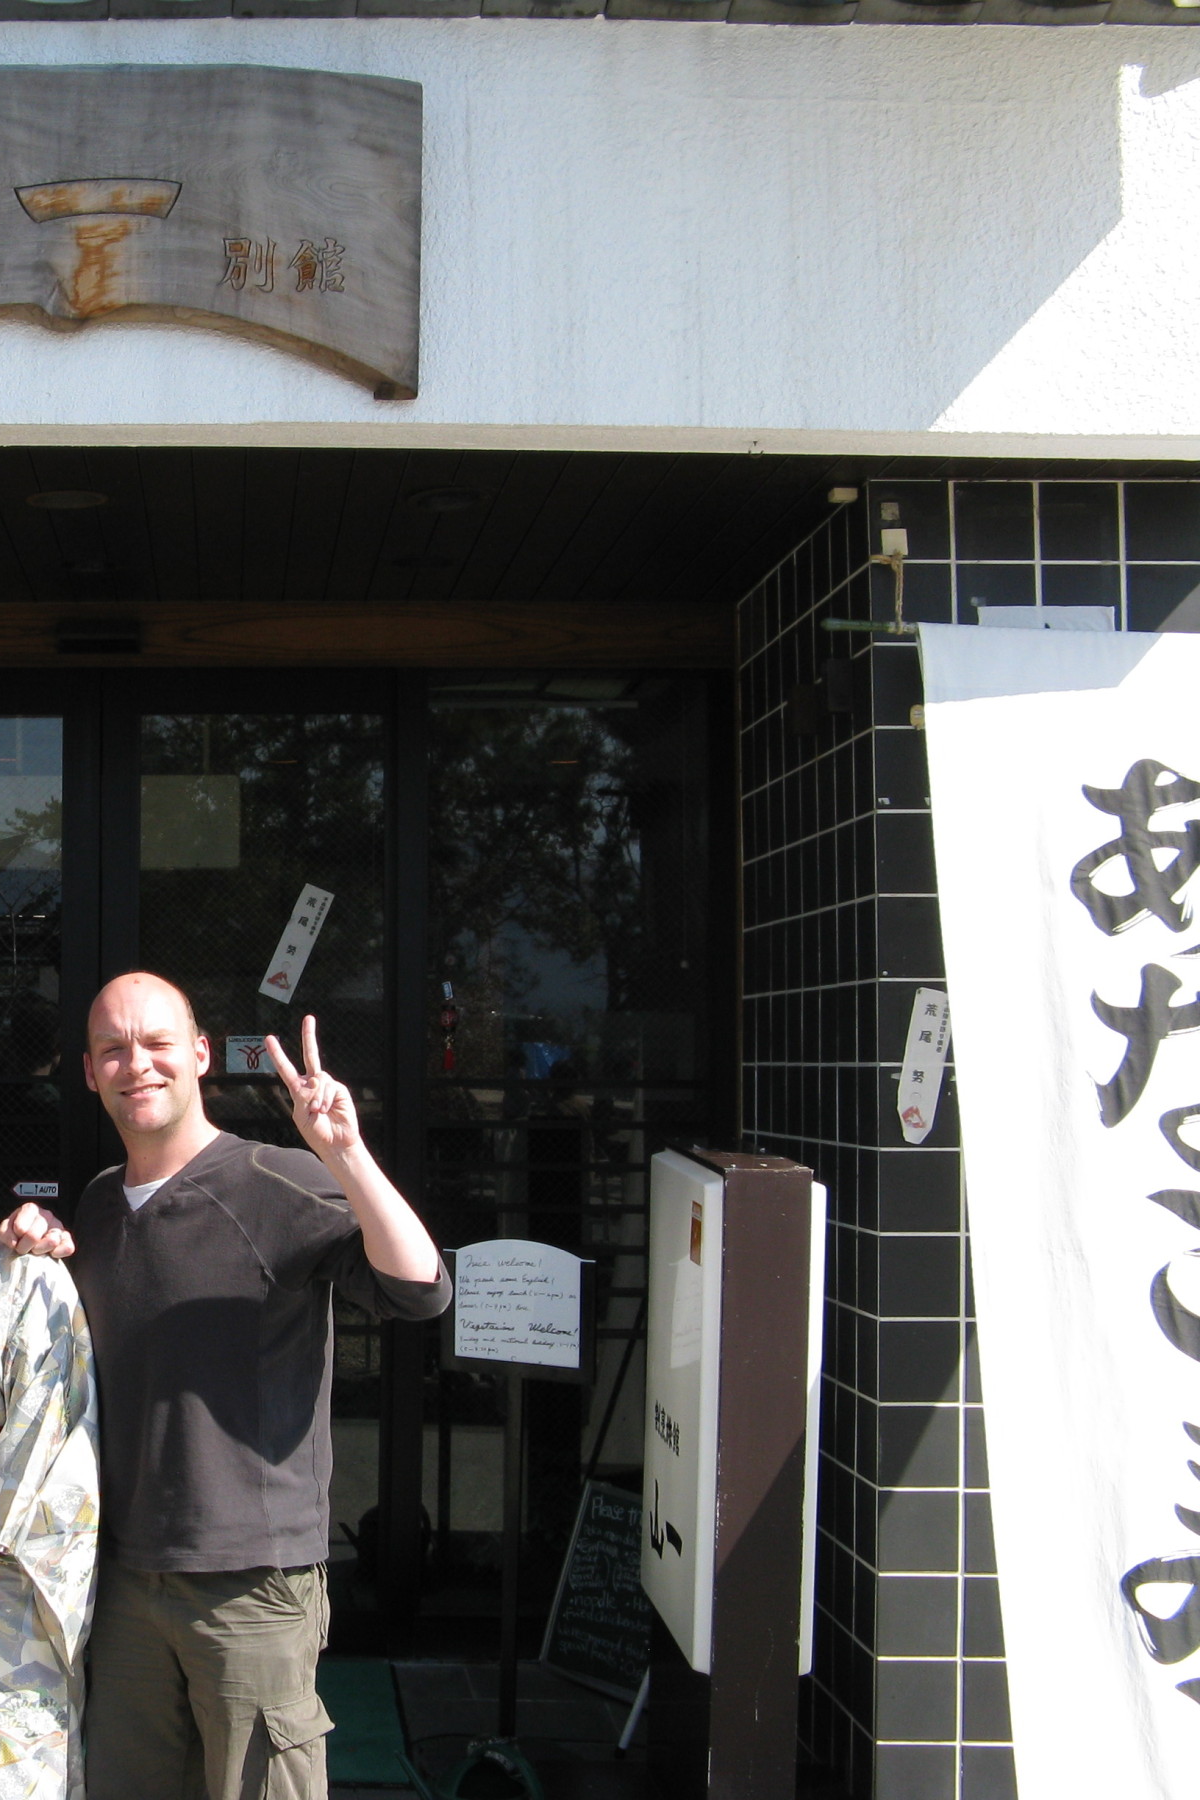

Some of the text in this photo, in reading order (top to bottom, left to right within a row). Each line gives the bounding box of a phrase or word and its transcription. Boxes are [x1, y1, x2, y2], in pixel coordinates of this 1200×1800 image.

[222, 236, 347, 294] 別館
[39, 1186, 57, 1194] AUTO
[591, 1496, 625, 1521] Please
[649, 1478, 683, 1560] 山一
